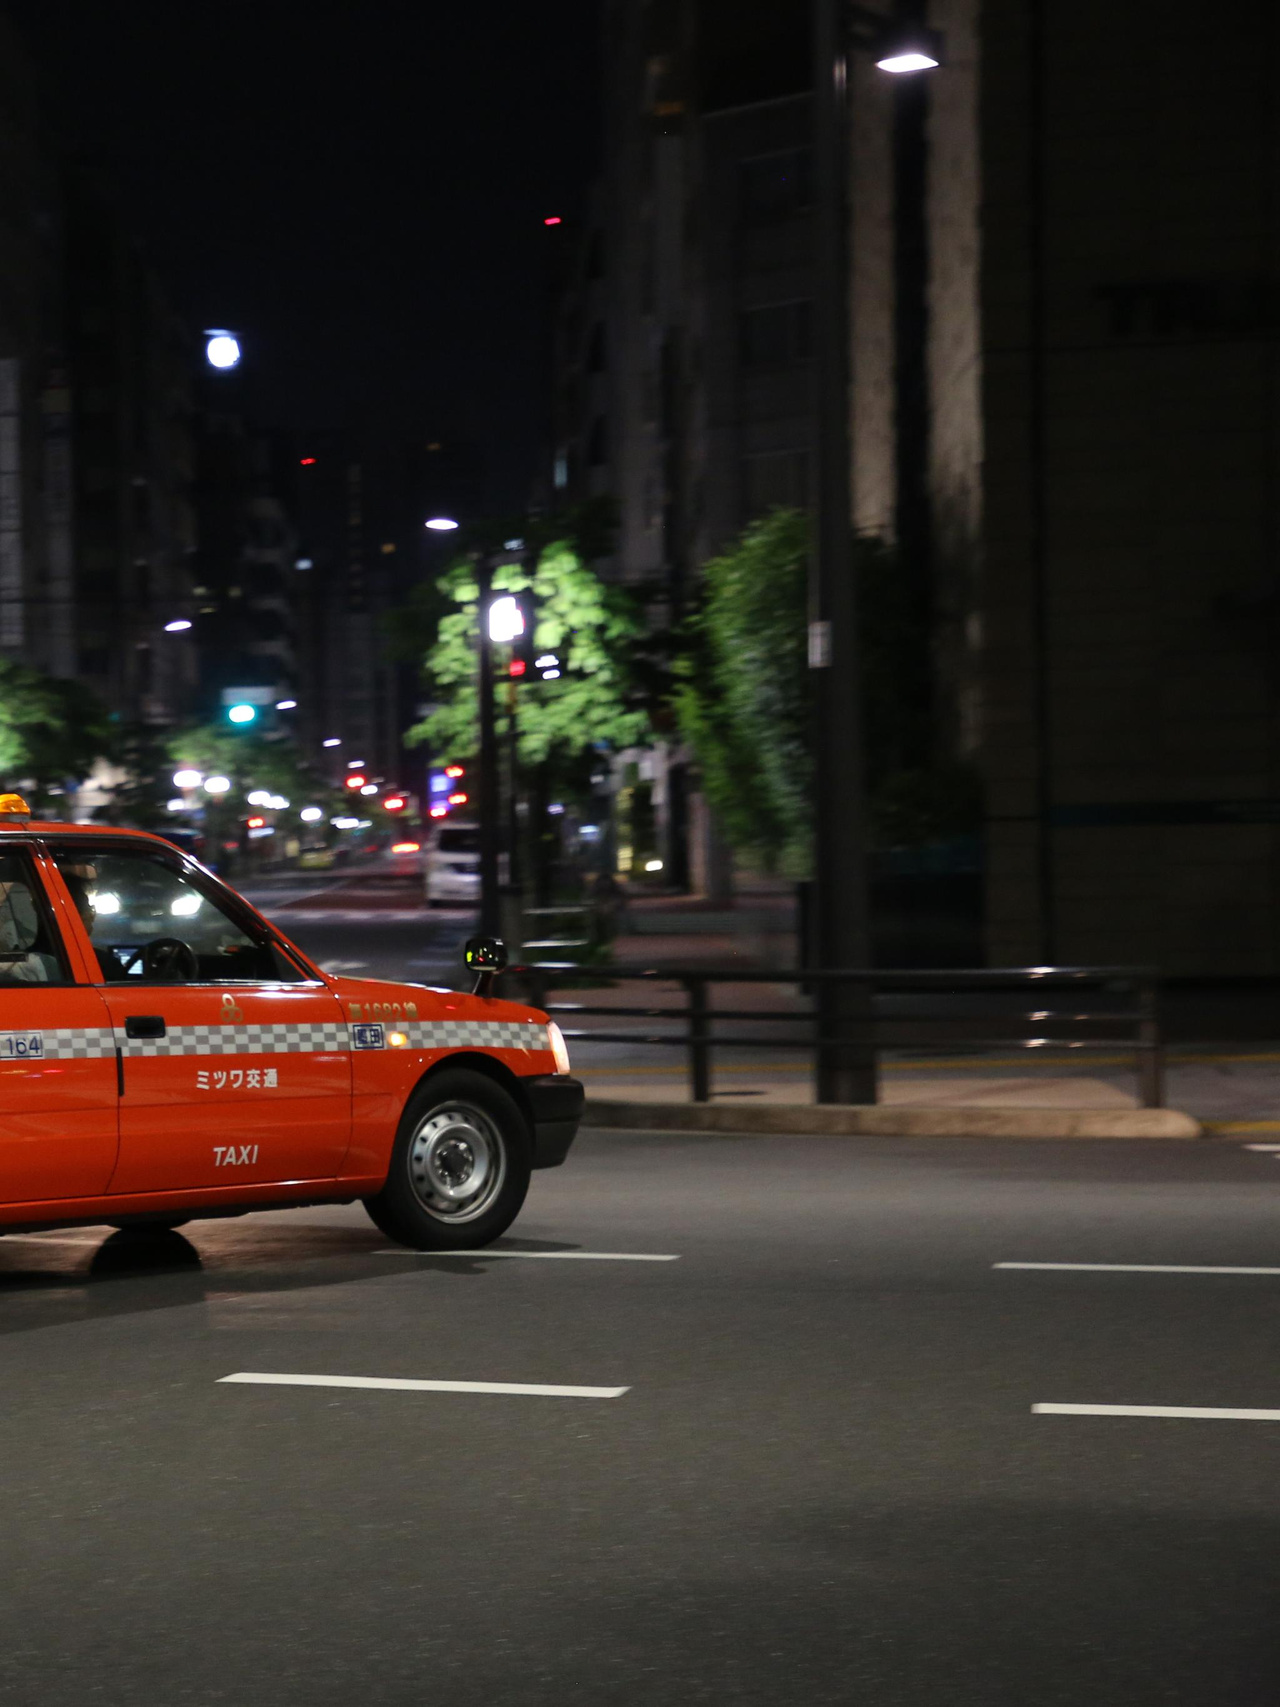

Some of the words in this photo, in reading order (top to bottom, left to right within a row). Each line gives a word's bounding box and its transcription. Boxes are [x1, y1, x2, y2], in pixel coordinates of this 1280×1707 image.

[6, 1035, 40, 1055] 164
[195, 1068, 279, 1091] ミツワ交通
[212, 1145, 259, 1167] TAXI
